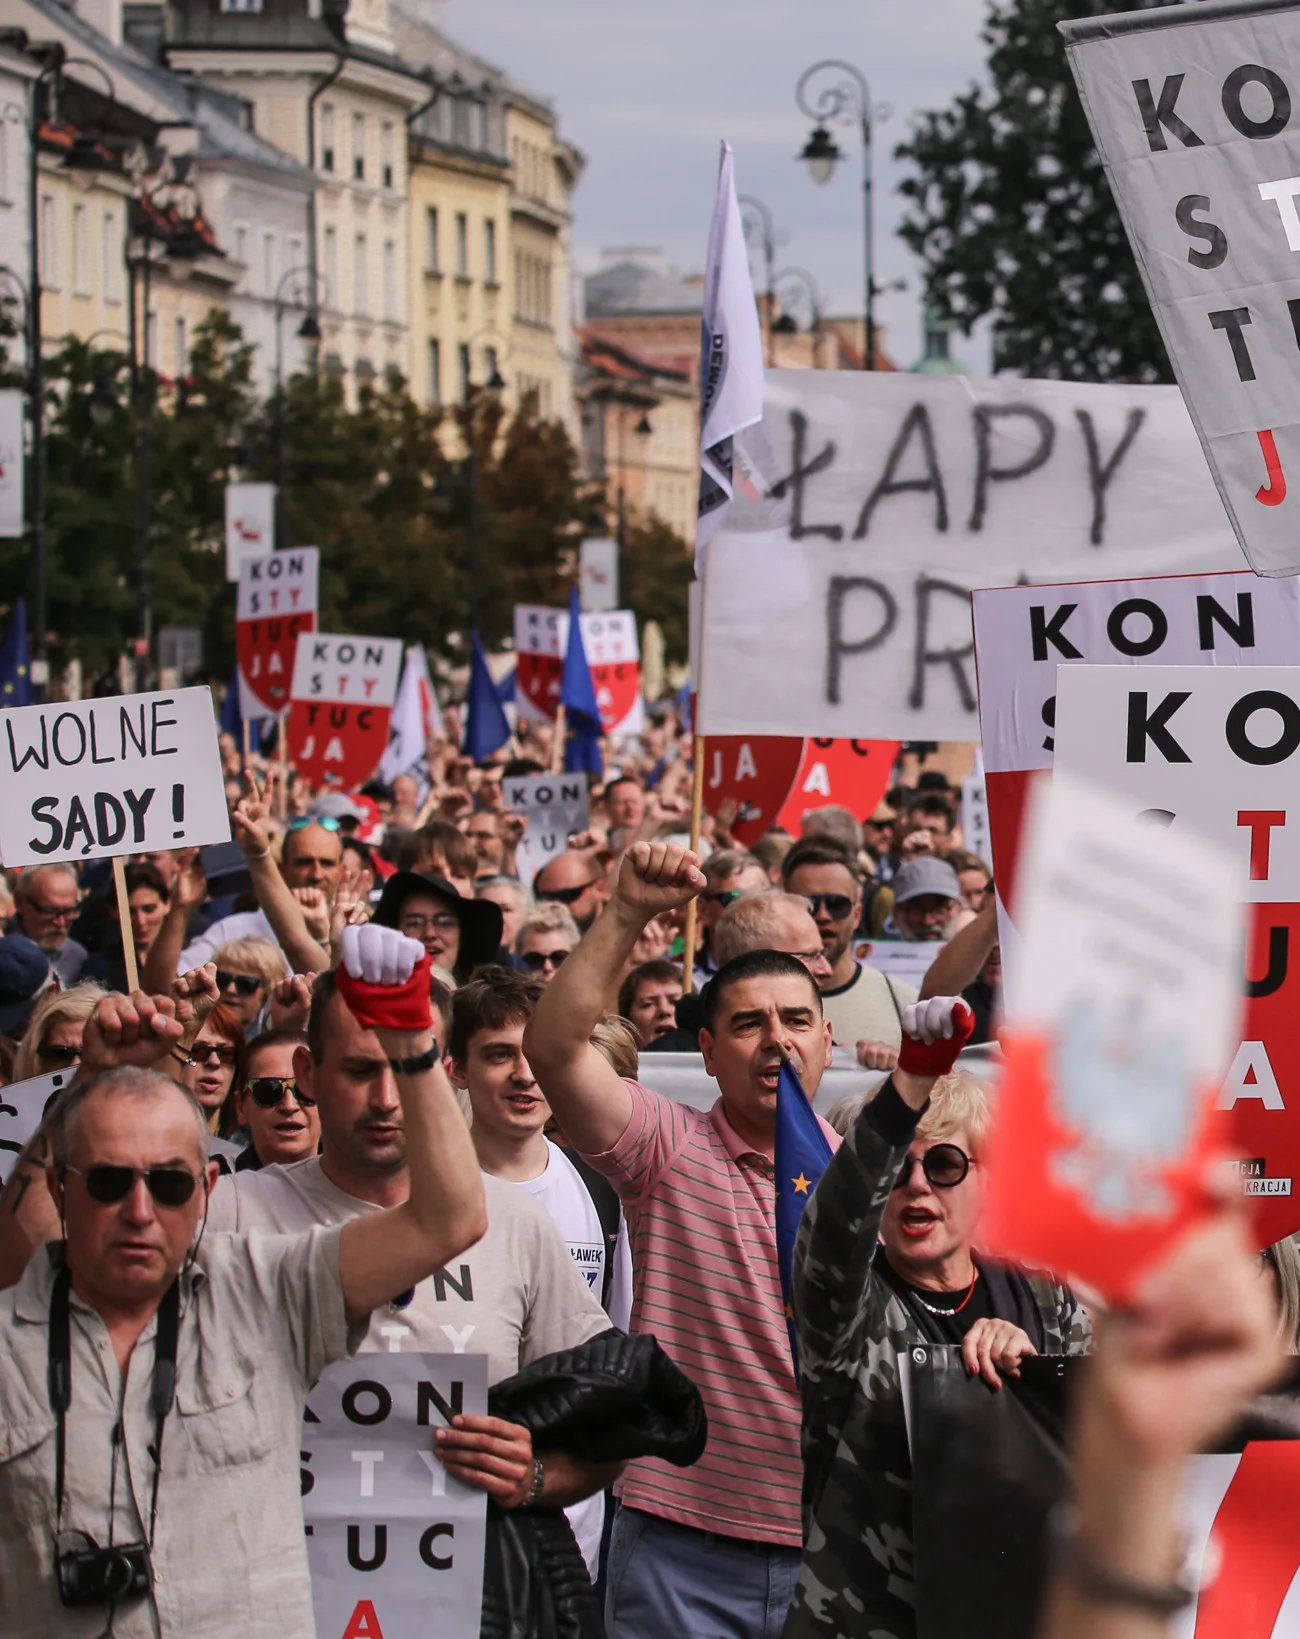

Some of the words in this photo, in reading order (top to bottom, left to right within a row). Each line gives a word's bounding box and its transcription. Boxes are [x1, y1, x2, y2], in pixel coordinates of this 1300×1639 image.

[763, 402, 1146, 545] ŁAPY
[251, 557, 303, 581] KON
[1029, 592, 1256, 661] KON
[312, 643, 384, 666] KON
[311, 673, 377, 698] STY
[5, 698, 179, 773] WOLNE
[307, 705, 373, 731] TUC
[300, 735, 344, 762] JA
[709, 742, 757, 789] JA
[512, 784, 579, 805] KON
[803, 761, 831, 797] A
[1213, 1040, 1286, 1111] A
[1245, 1181, 1287, 1193] KRACJA
[304, 1522, 455, 1572] UC
[342, 1599, 384, 1639] A
